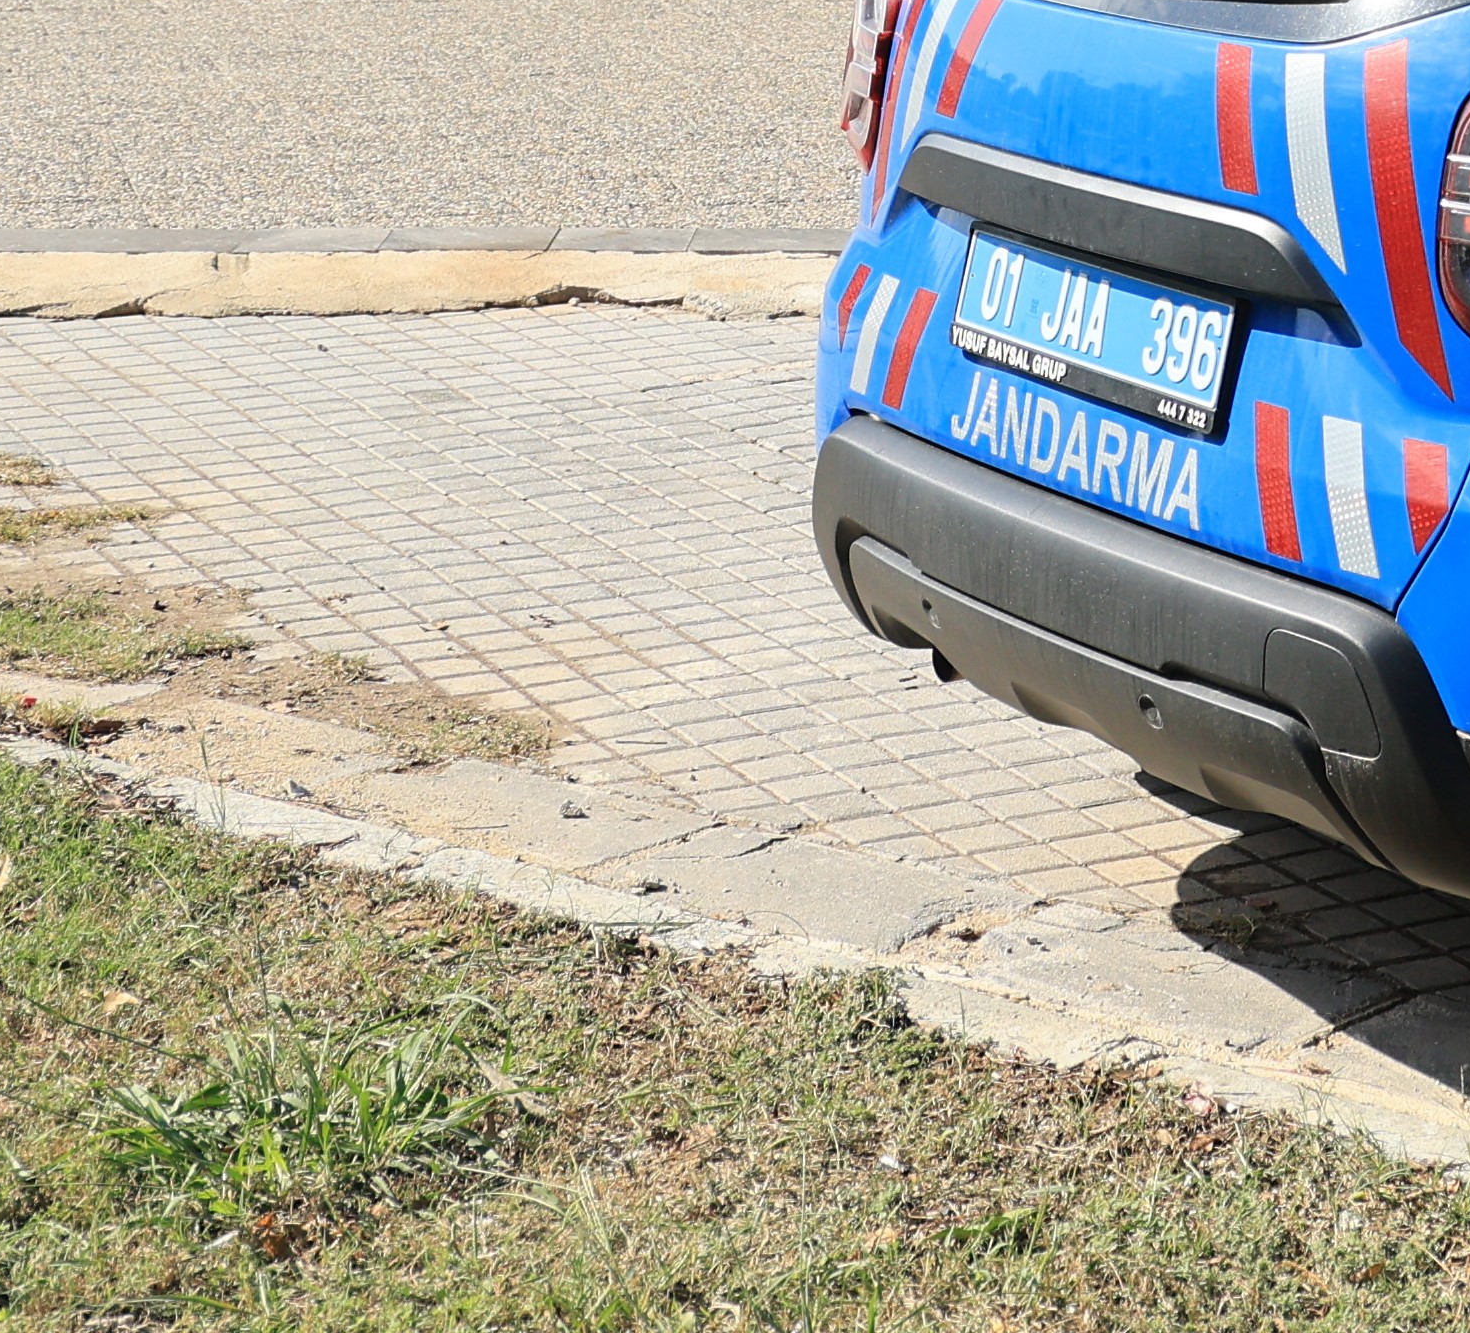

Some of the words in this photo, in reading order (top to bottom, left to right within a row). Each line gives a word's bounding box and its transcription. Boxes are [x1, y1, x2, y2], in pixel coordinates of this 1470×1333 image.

[952, 325, 988, 354] YUSUF
[987, 338, 1031, 371] BAYSAL
[1032, 355, 1067, 382] GRUP
[981, 247, 1025, 328] 01
[1040, 268, 1111, 358] JAA
[1142, 298, 1223, 391] 396
[951, 371, 1200, 531] JANDARMA
[1157, 399, 1177, 419] 444
[1178, 405, 1187, 421] 7
[1186, 408, 1207, 429] 322
